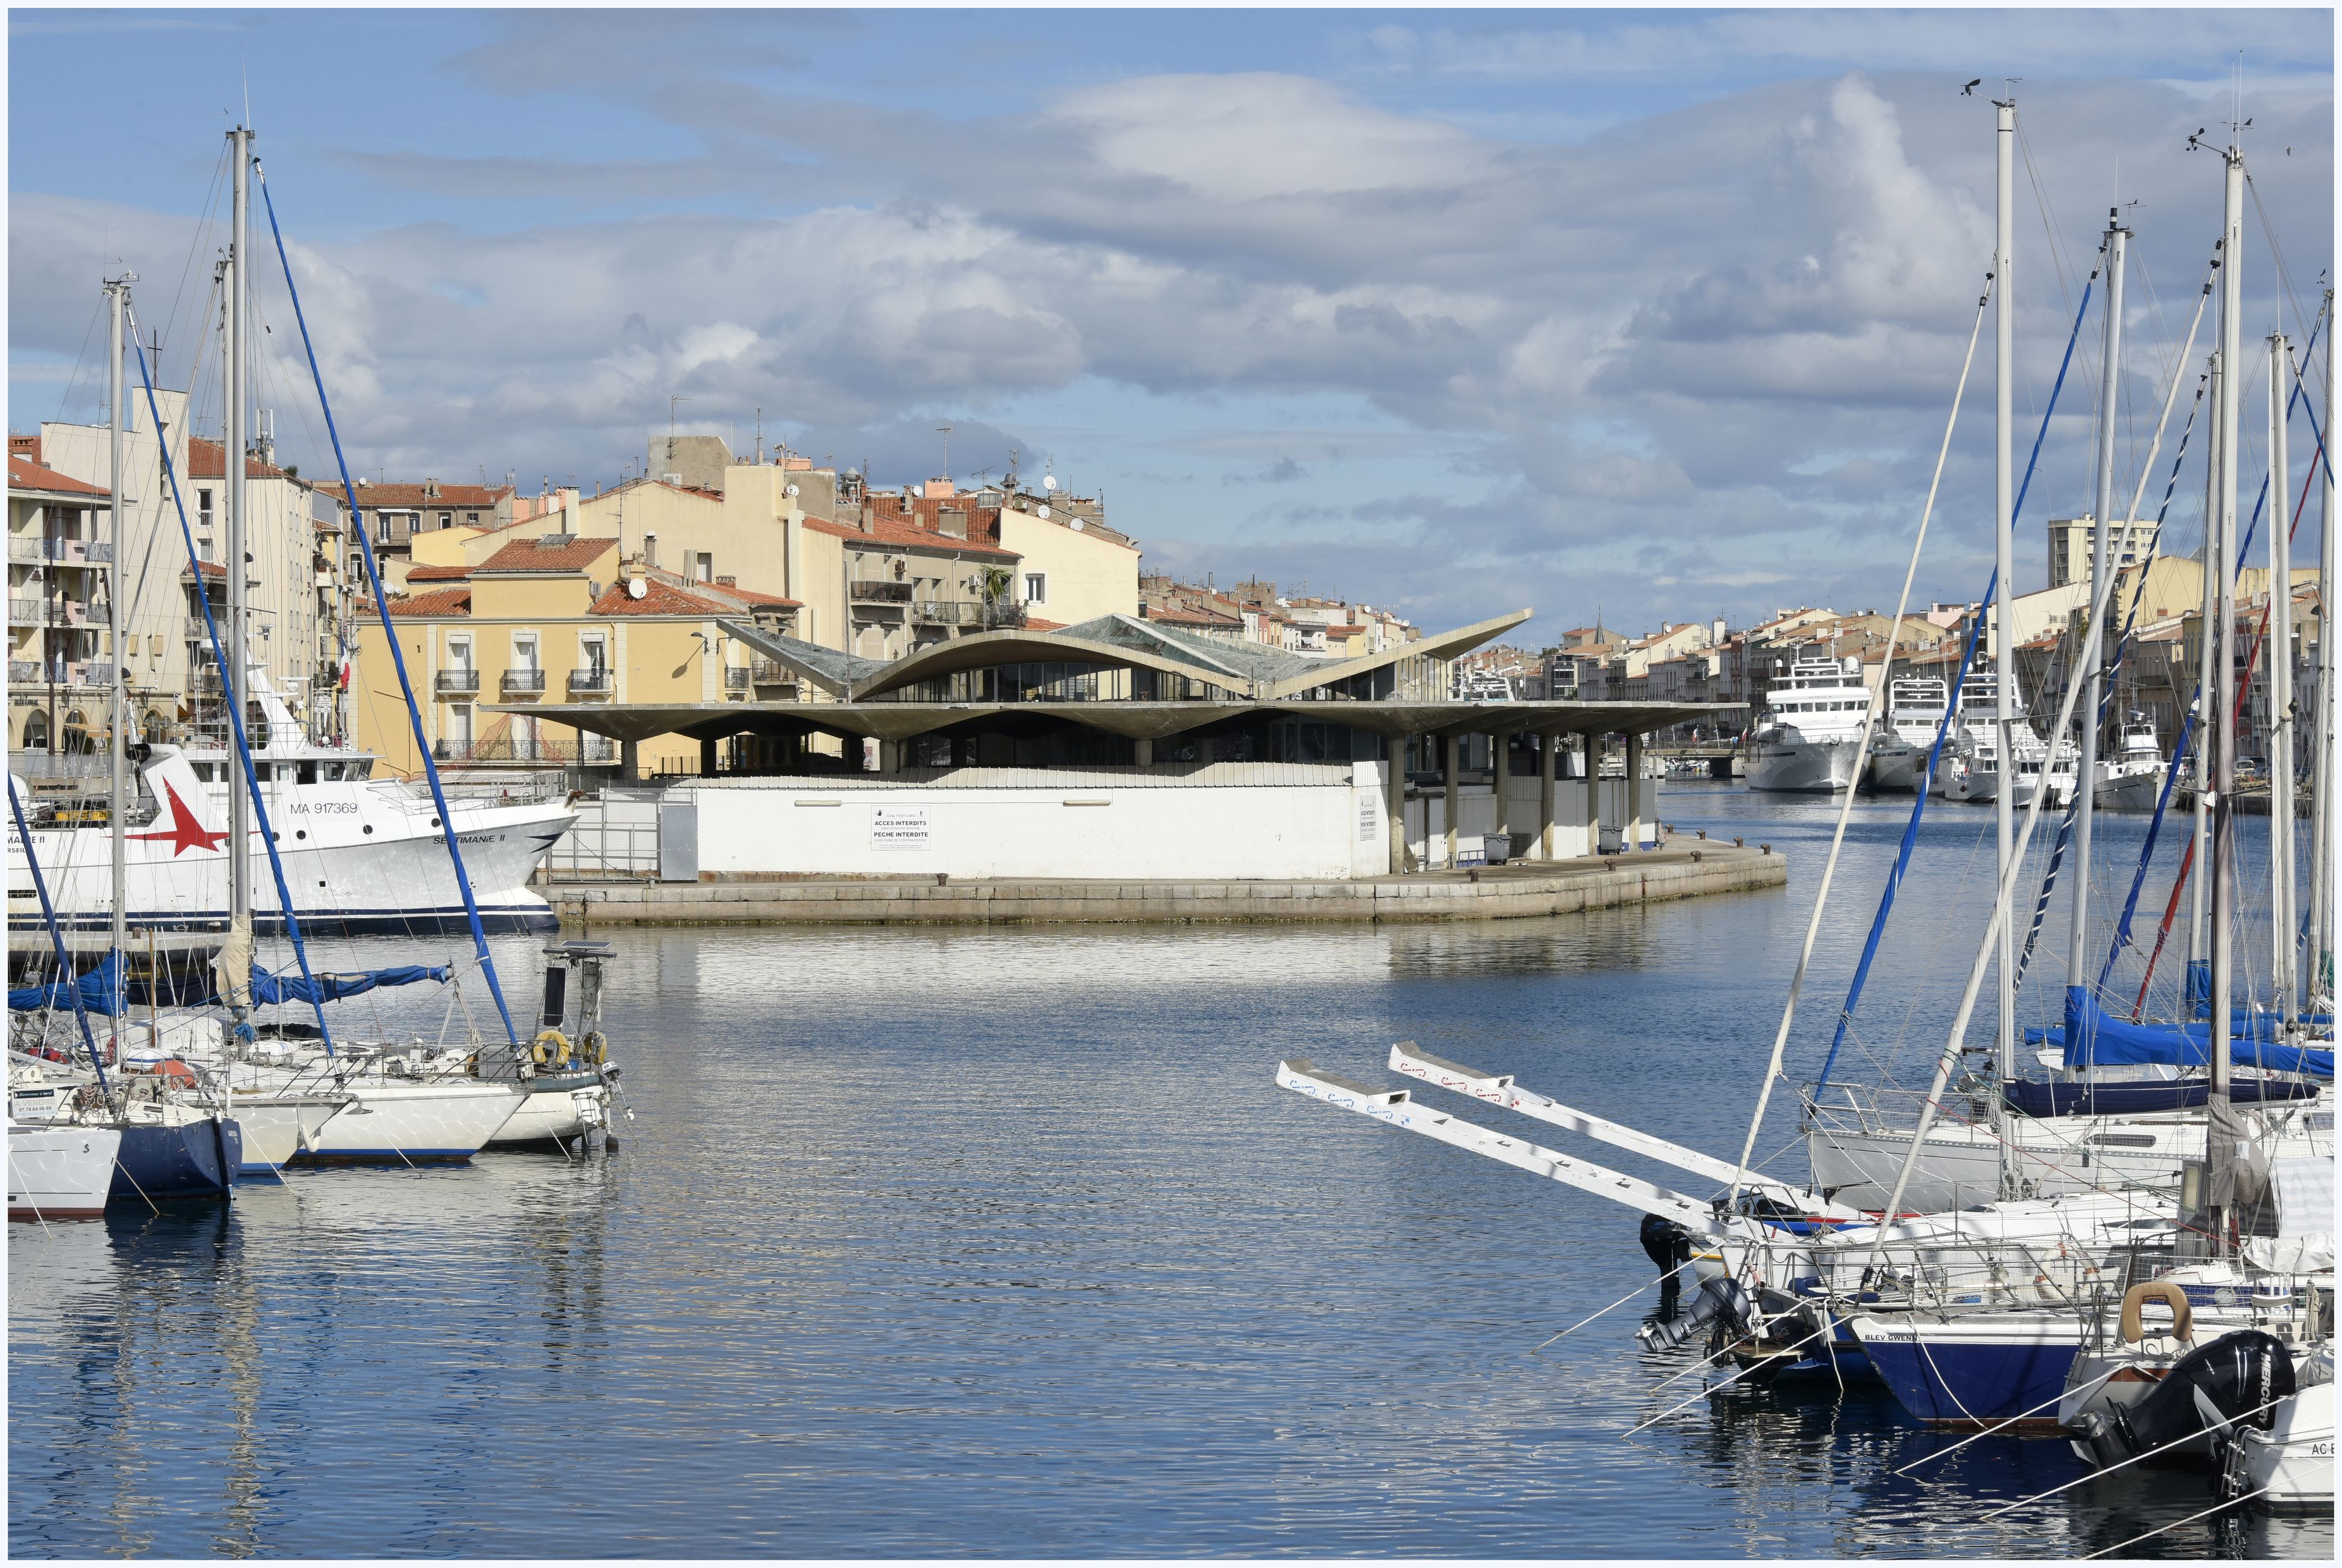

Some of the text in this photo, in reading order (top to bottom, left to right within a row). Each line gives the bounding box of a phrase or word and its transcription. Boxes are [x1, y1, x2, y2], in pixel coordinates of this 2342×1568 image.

[290, 803, 357, 814] MA 917369
[433, 835, 496, 844] SETIMANIE
[23, 1098, 55, 1107] VENDRE
[2258, 1352, 2271, 1426] MERCURY
[2312, 1443, 2327, 1455] AC
